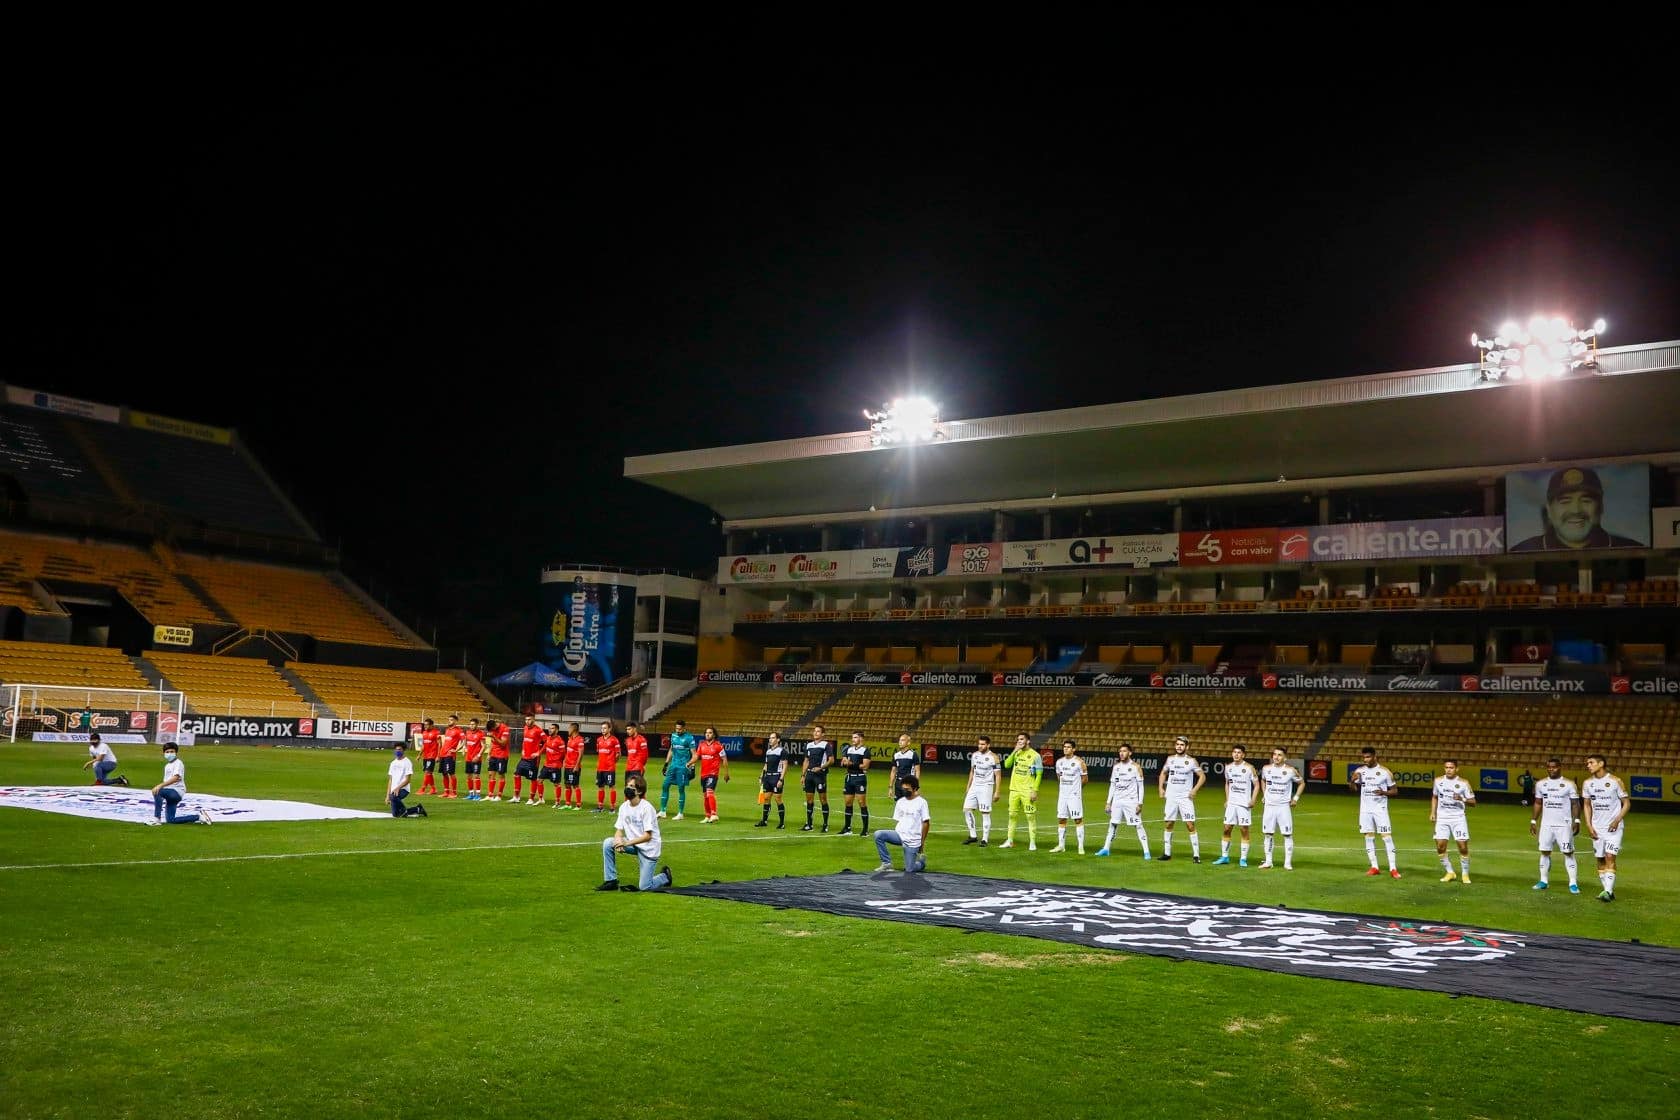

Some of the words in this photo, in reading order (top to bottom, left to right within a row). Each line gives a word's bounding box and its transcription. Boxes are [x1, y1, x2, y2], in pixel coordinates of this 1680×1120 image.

[1313, 526, 1504, 556] caliente.mx
[1231, 548, 1248, 556] con
[1251, 546, 1273, 555] valor
[562, 592, 588, 672] Corona
[585, 614, 601, 650] Extra
[709, 671, 762, 682] caliente.mx
[784, 671, 841, 683] caliente.mx
[912, 672, 977, 684] caliente.mx
[1004, 673, 1076, 686] caliente.mx
[1165, 674, 1246, 687] caliente.mx
[1278, 675, 1367, 688] caliente.mx
[1387, 674, 1439, 690] Caliente
[1480, 676, 1585, 691] caliente.mx
[1632, 677, 1680, 693] calie
[181, 718, 293, 738] caliente.mx
[946, 751, 964, 761] USA
[1393, 769, 1435, 785] oppel
